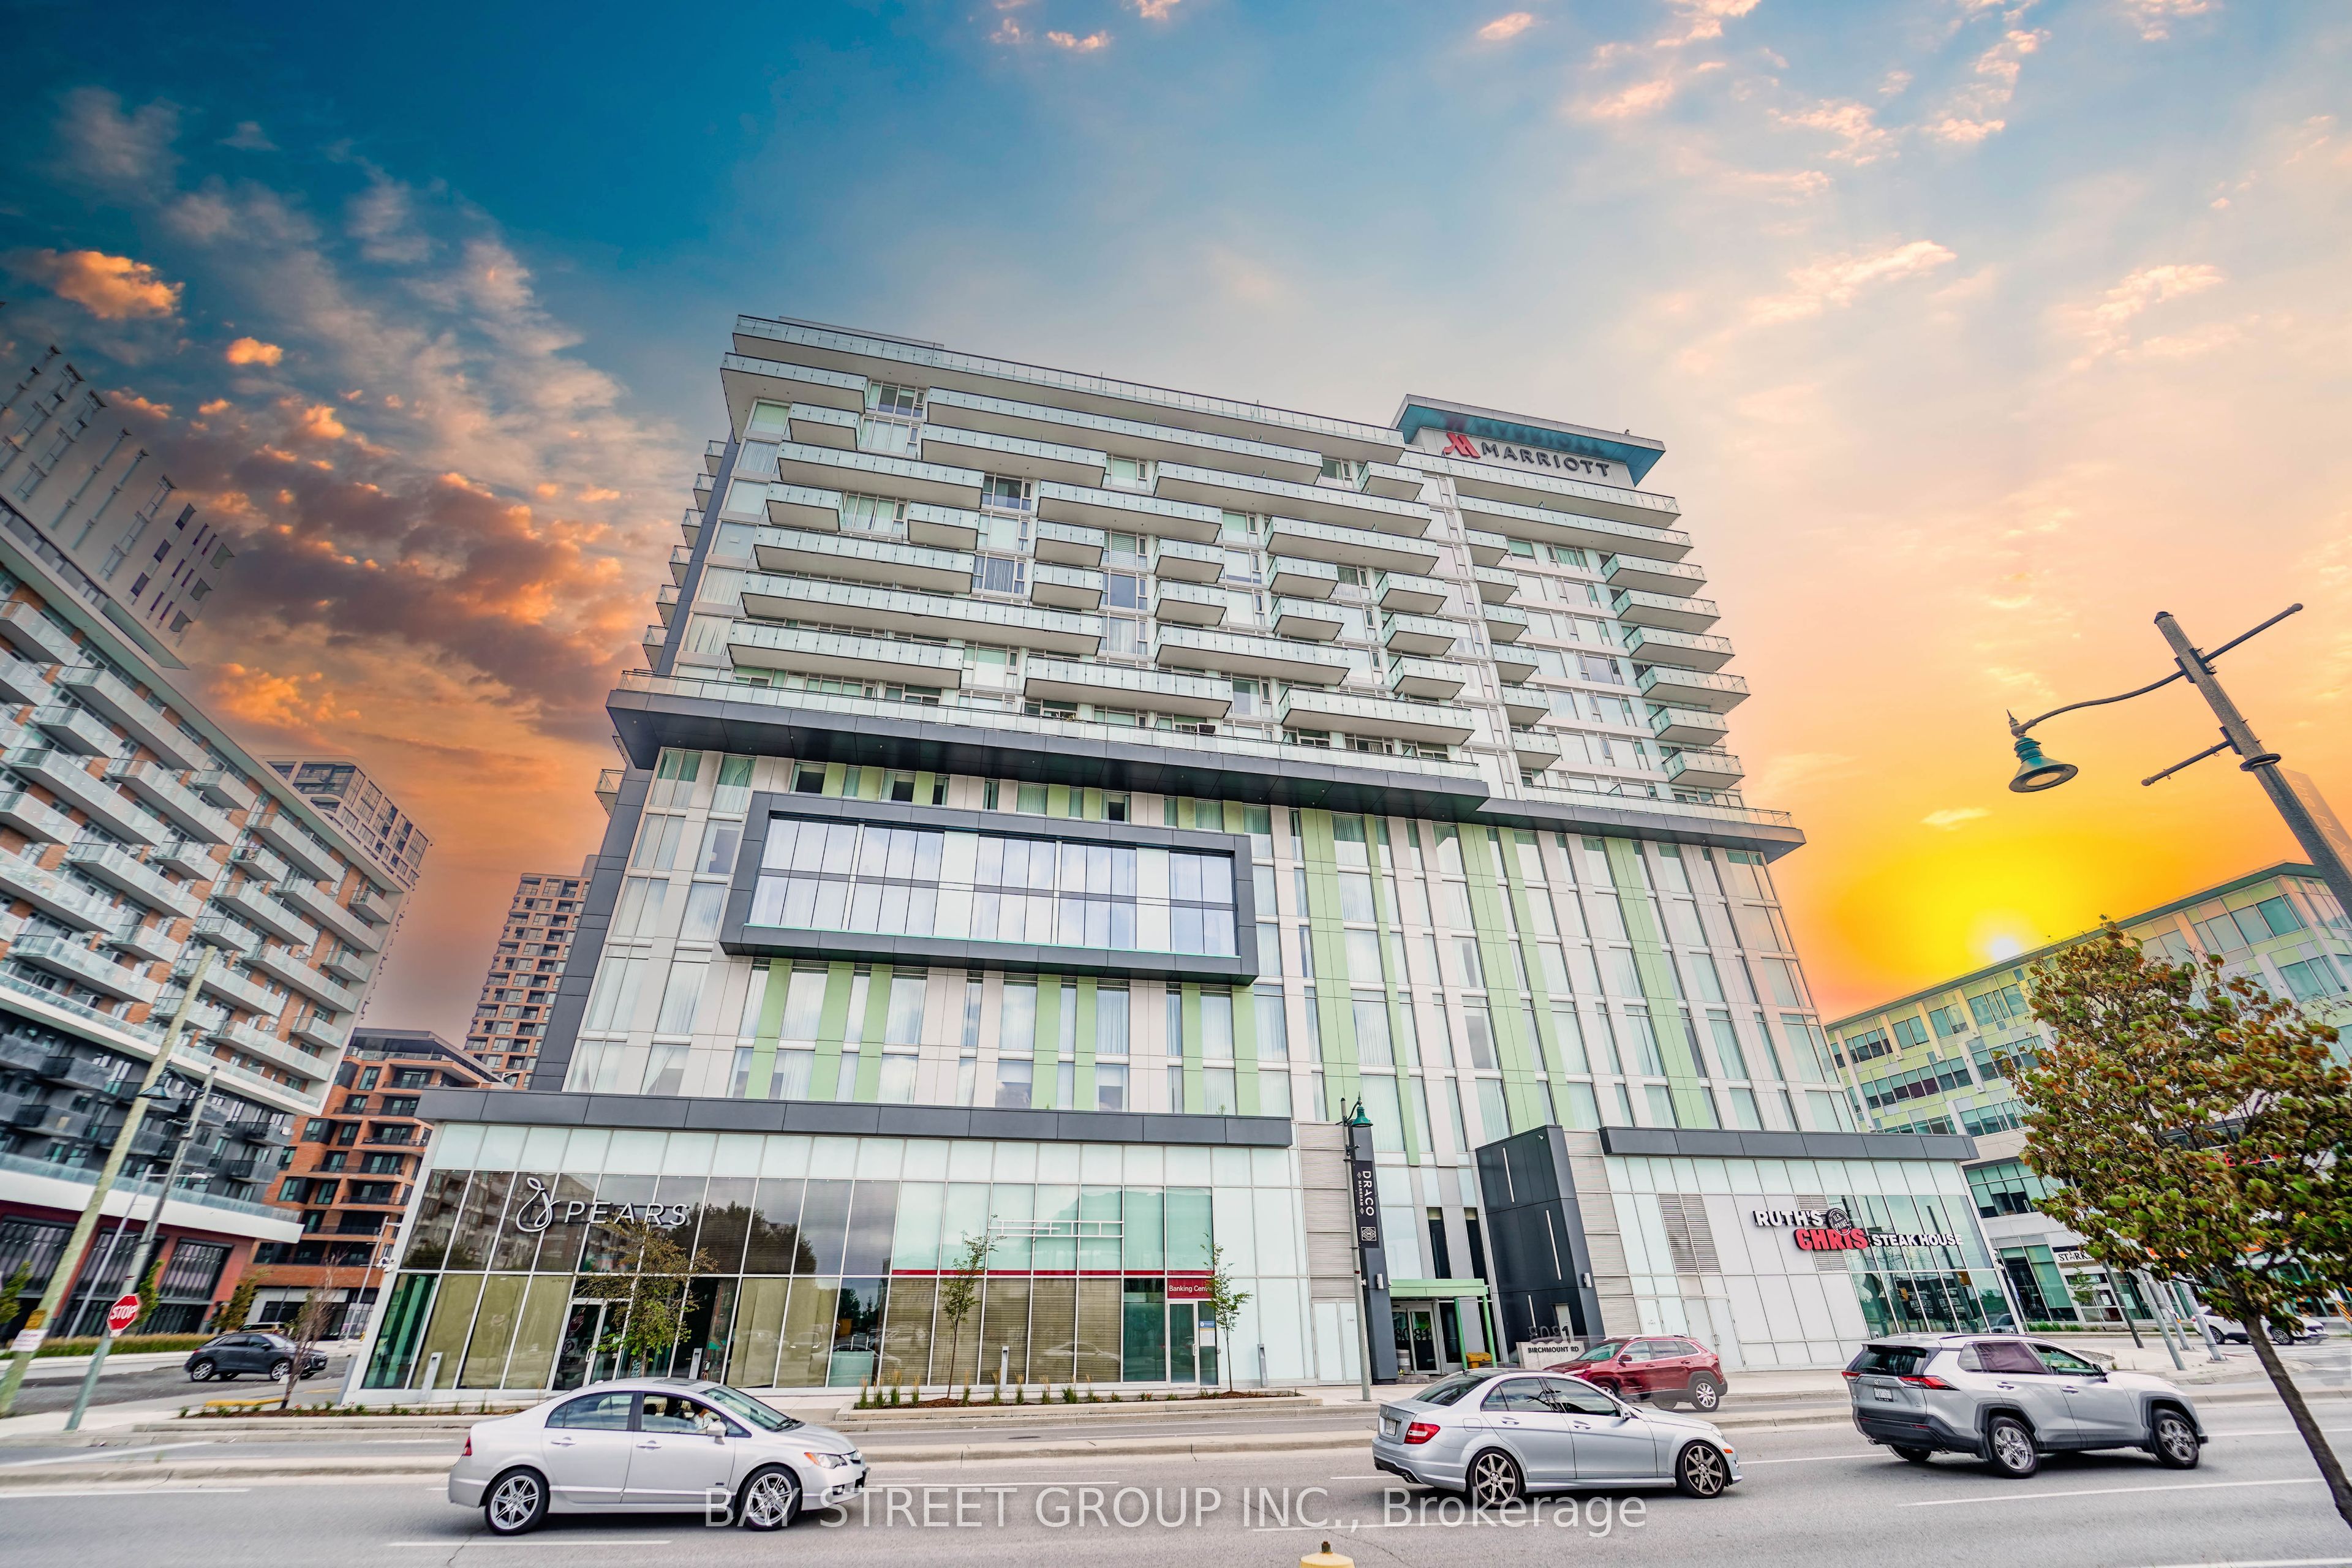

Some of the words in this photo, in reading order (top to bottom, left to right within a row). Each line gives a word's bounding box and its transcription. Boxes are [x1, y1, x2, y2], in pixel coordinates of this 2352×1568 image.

[1481, 442, 1610, 477] MARRIOTT
[1362, 1170, 1374, 1216] DRACO
[564, 1200, 690, 1226] PEARS
[1754, 1210, 1824, 1226] RUTH'S
[1833, 1213, 1843, 1222] U.S.
[1834, 1219, 1849, 1231] PRIME
[1795, 1228, 1869, 1250] CHRIS
[1872, 1234, 1918, 1246] STEAK
[1919, 1234, 1964, 1246] HOUSE
[110, 1305, 138, 1321] STOP
